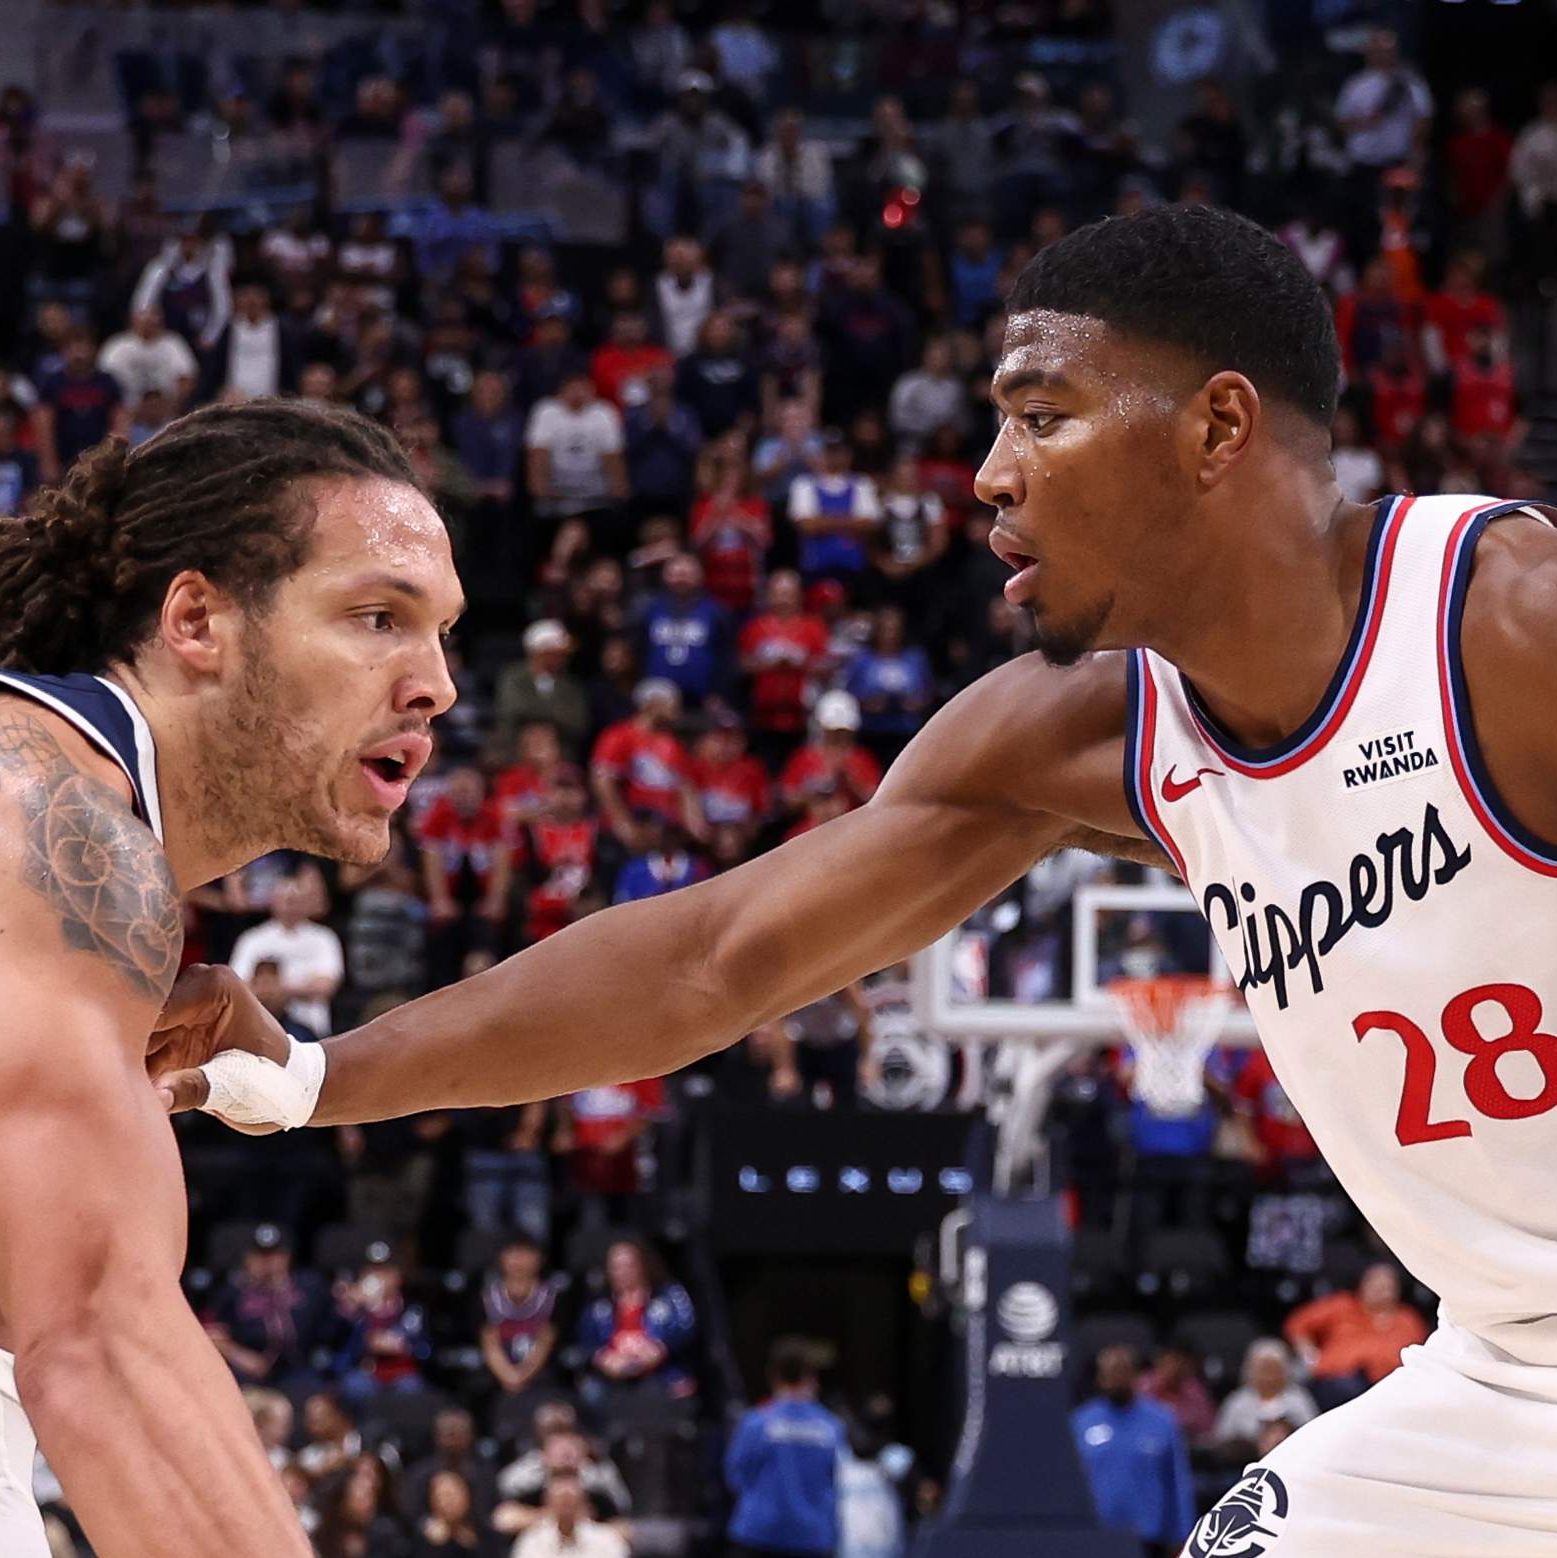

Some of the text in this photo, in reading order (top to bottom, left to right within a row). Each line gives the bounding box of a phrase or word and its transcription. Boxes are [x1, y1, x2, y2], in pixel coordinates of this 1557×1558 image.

[1358, 730, 1414, 761] VISIT
[1343, 747, 1439, 788] RWANDA
[1203, 802, 1472, 1010] Cippers
